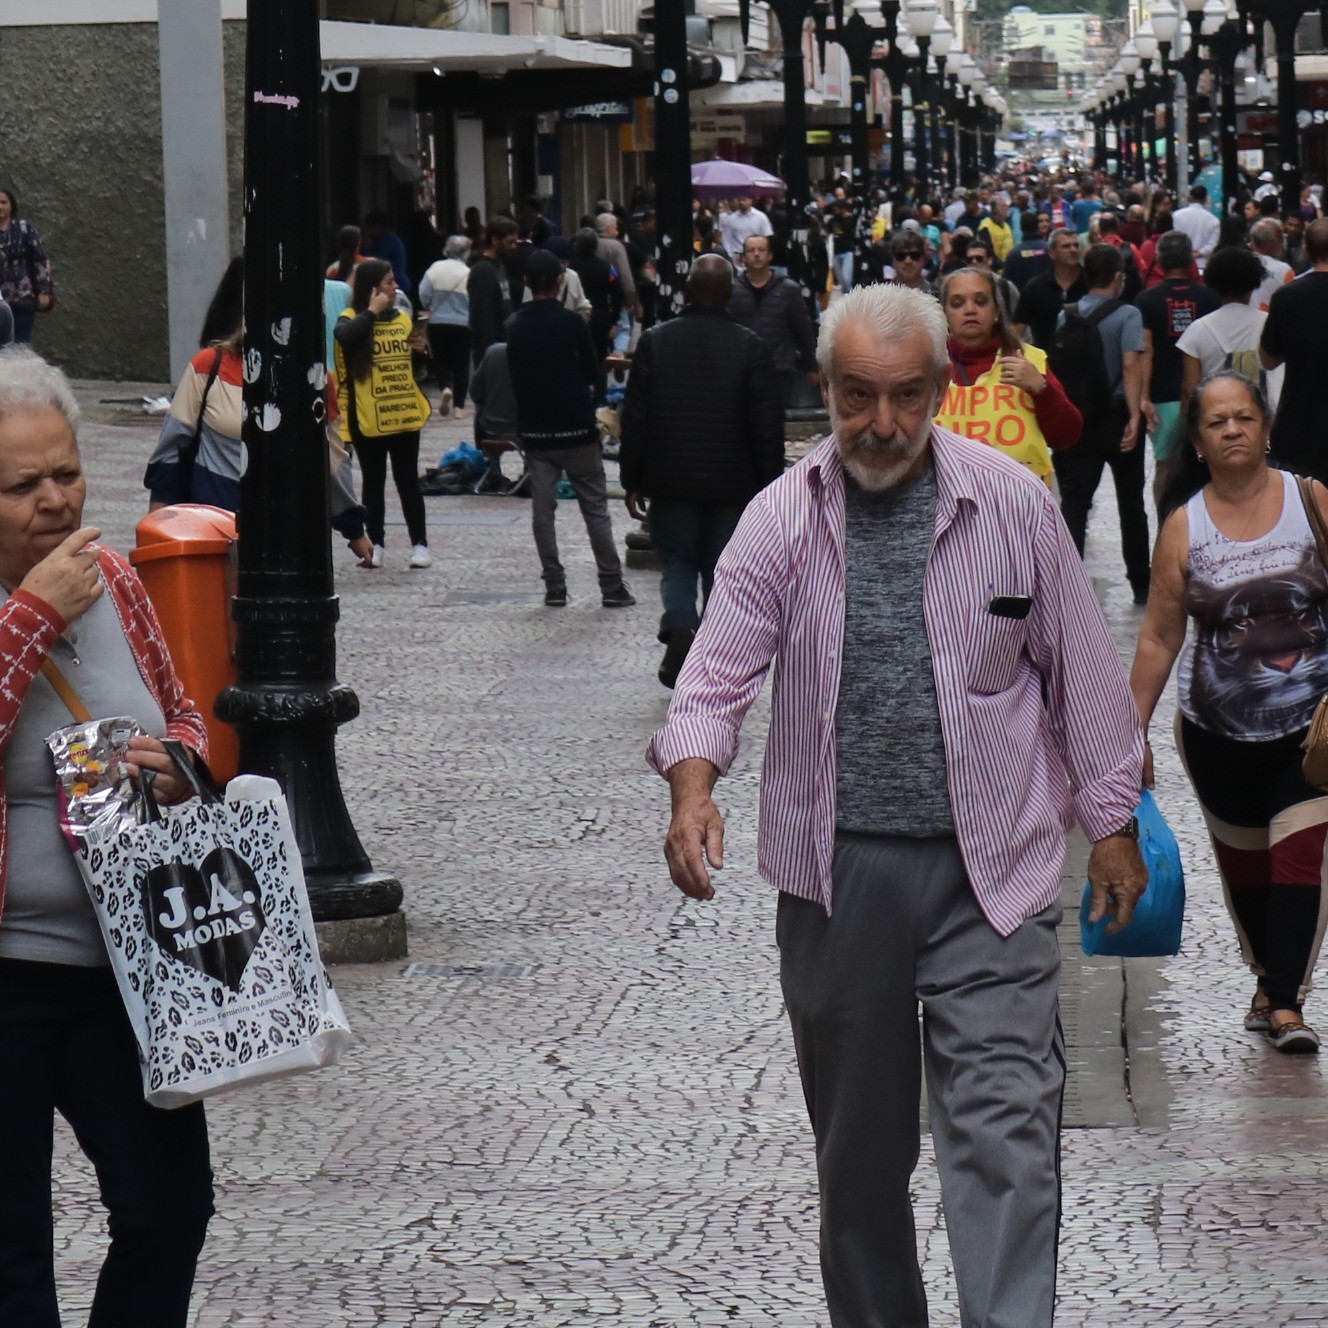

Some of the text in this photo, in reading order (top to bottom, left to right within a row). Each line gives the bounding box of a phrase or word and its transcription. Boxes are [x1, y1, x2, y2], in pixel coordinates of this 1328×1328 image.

[373, 339, 409, 355] OURO
[378, 362, 410, 373] MELHOR
[375, 386, 387, 394] DA
[941, 384, 1036, 417] MPRO
[158, 873, 255, 929] J.A.
[172, 908, 257, 952] MODAS
[192, 1016, 216, 1028] Jeans
